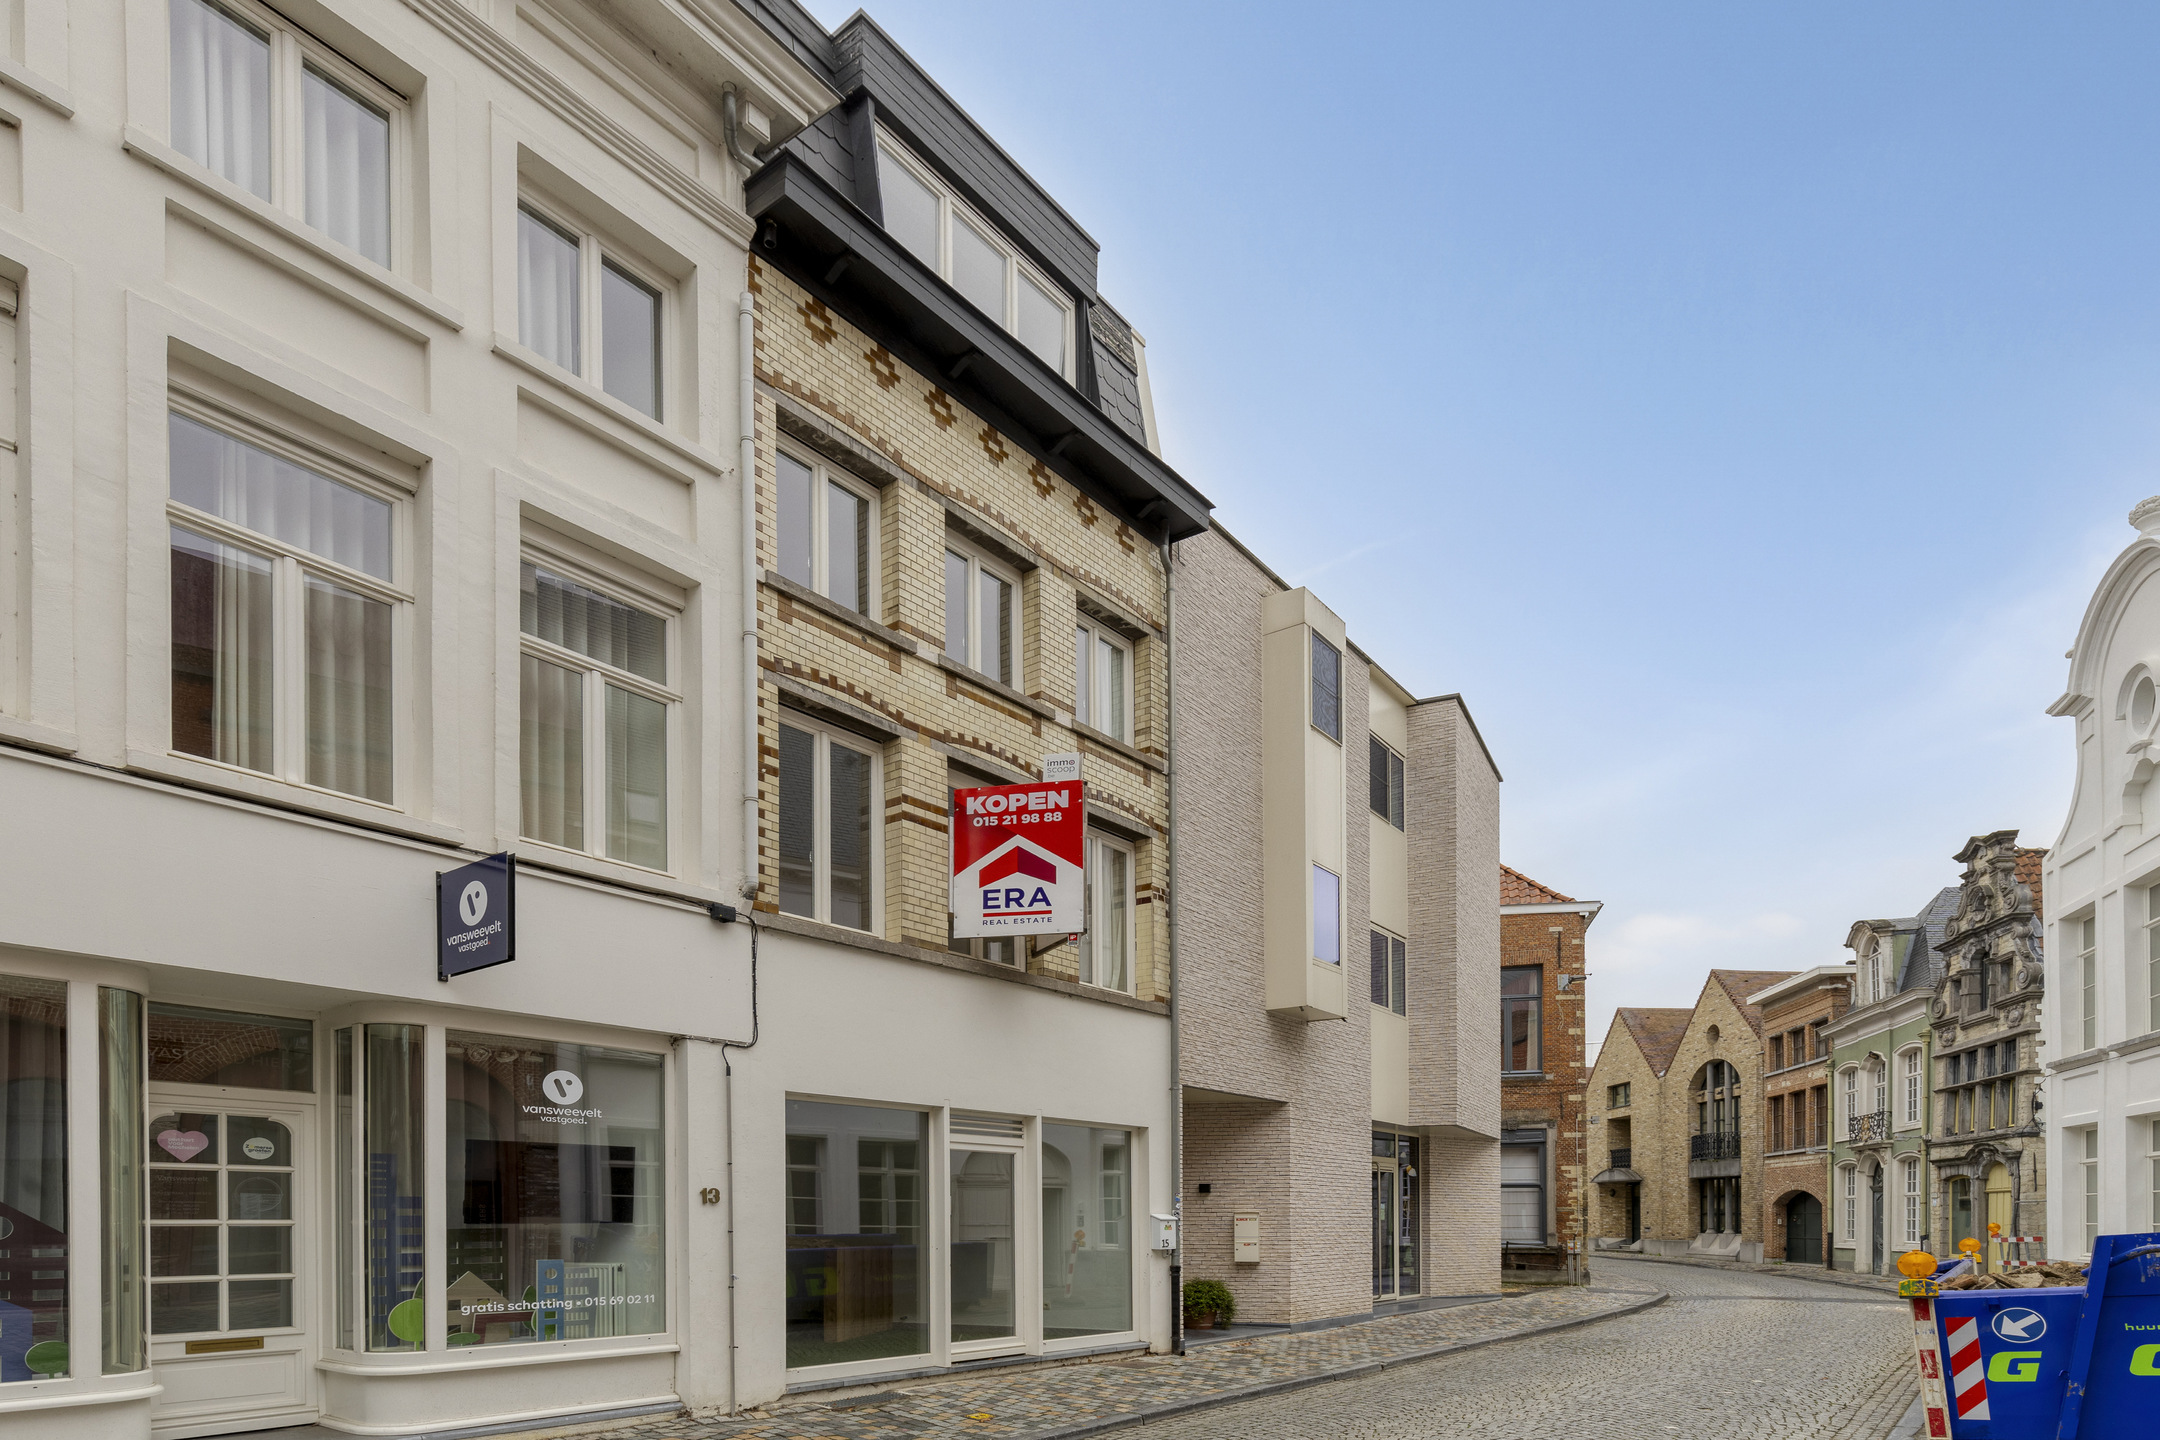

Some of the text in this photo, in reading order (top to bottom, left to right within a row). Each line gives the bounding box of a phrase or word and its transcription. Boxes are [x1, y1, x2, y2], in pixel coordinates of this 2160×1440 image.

[966, 789, 1069, 815] KOPEN
[973, 811, 1063, 827] 015 21 98 88
[983, 886, 1053, 910] ERA
[1013, 916, 1053, 925] ESTATE
[446, 920, 502, 946] vansweevelt
[522, 1105, 603, 1119] vansweevelt
[700, 1187, 720, 1204] 13
[1161, 1238, 1170, 1248] 15
[461, 1294, 655, 1316] gratis schatting 015 69 02 11
[1987, 1351, 2042, 1382] G
